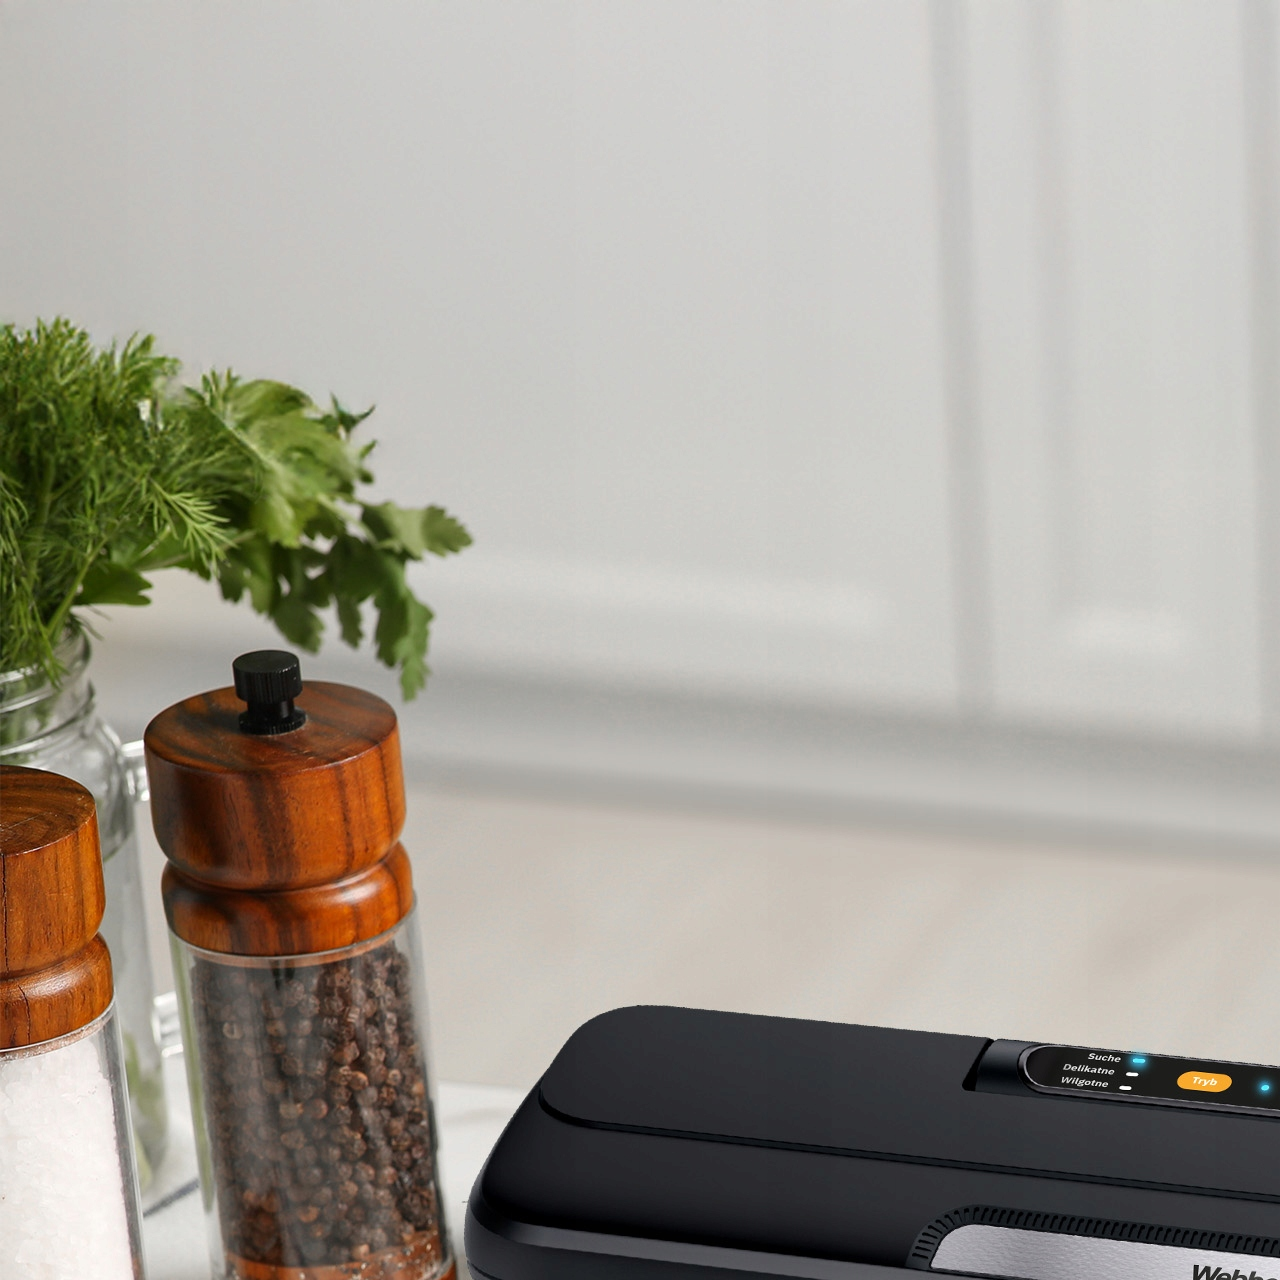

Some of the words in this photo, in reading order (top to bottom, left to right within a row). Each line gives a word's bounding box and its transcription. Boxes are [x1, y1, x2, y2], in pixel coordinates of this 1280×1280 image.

[1088, 1052, 1122, 1063] Suche
[1062, 1063, 1115, 1075] Delikatne
[1061, 1076, 1109, 1088] Wilgotne
[1192, 1076, 1218, 1087] Tryb
